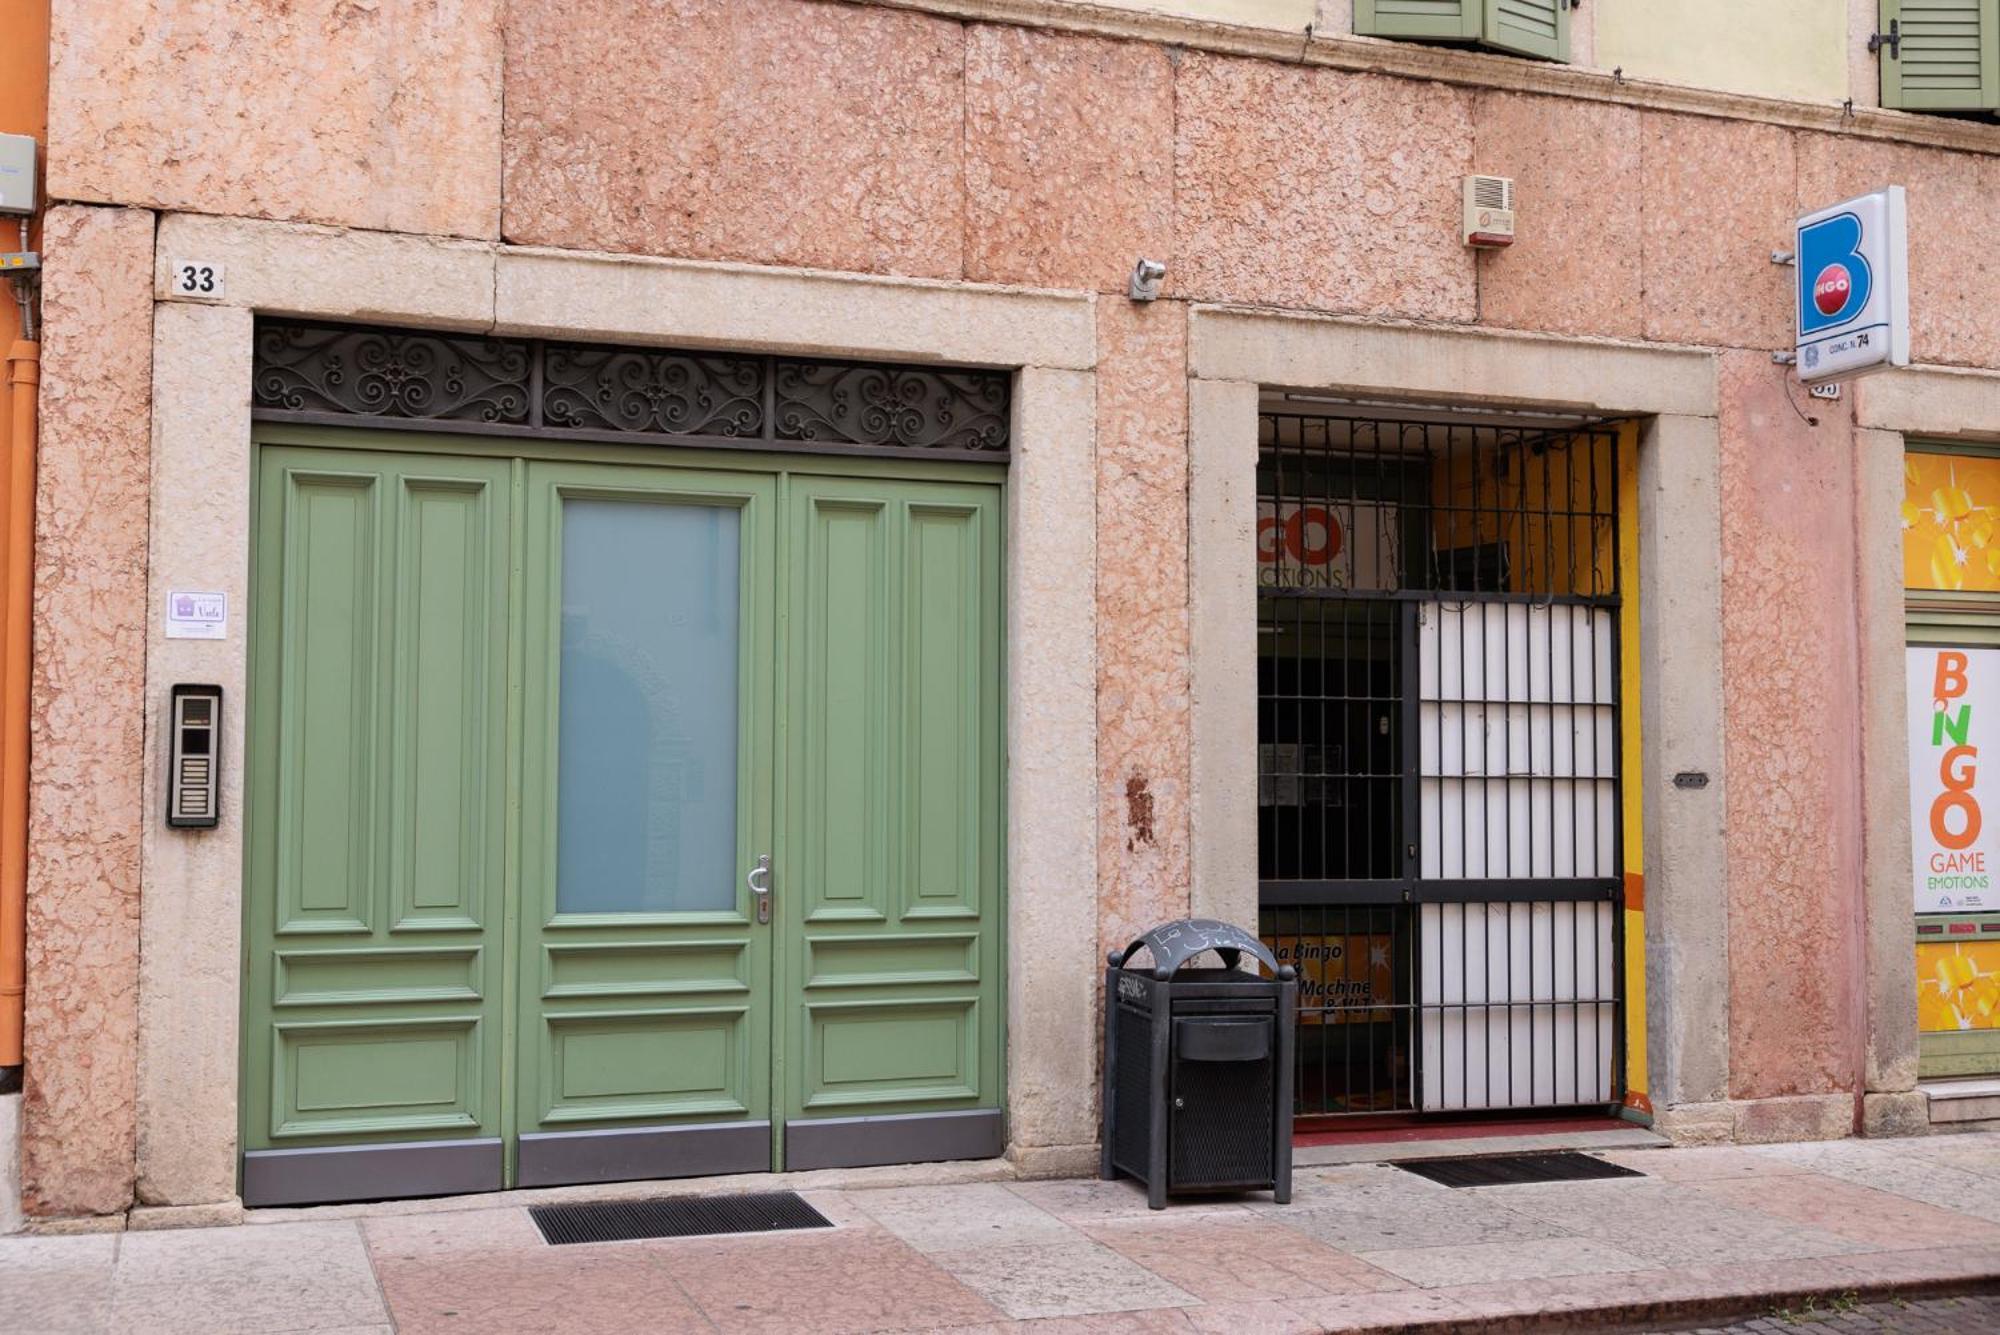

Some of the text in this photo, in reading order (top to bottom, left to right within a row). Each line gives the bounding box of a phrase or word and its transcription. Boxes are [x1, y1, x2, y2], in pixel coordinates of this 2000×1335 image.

[182, 265, 214, 292] 33
[1857, 333, 1869, 348] 74
[1257, 506, 1343, 566] GO
[1257, 566, 1343, 588] OTIONS
[1930, 852, 1986, 873] GAME
[1927, 875, 1990, 890] EMOTIONS
[1294, 943, 1342, 962] Bingo
